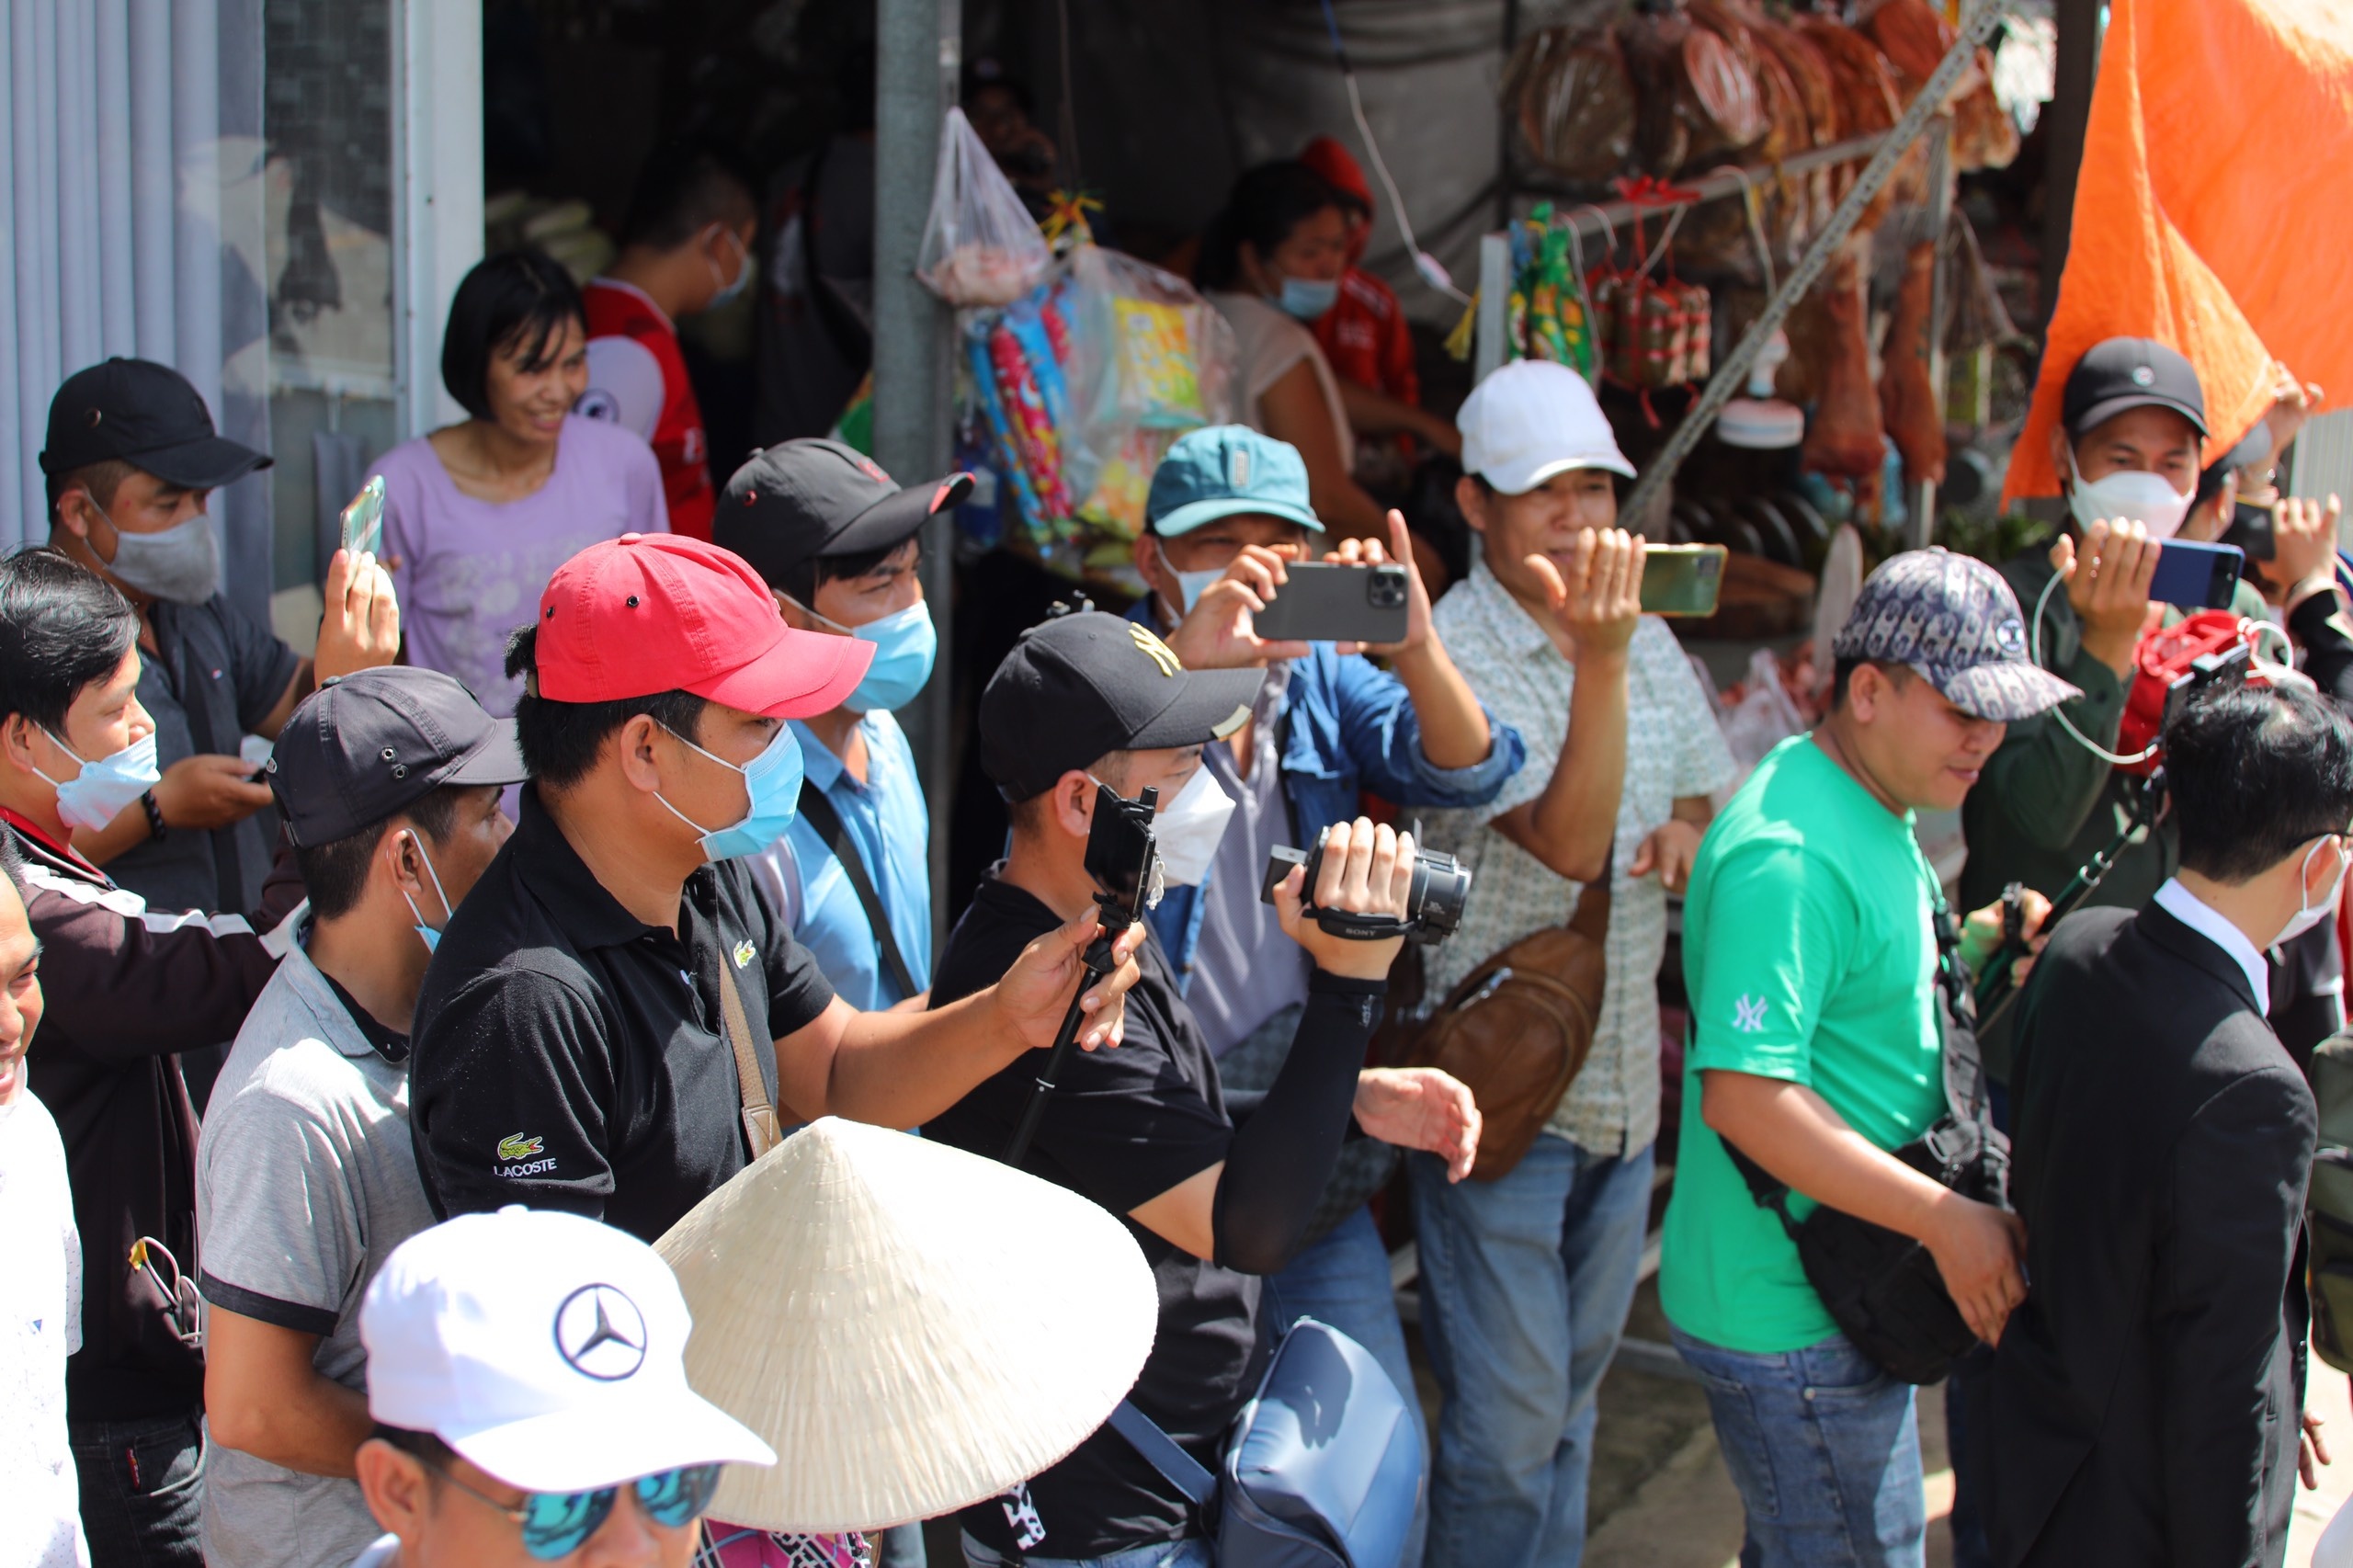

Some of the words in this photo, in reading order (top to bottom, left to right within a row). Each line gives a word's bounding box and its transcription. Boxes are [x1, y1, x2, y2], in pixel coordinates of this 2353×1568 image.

[1345, 927, 1376, 937] SONY
[1732, 992, 1768, 1032] NY
[493, 1157, 558, 1177] LACOSTE
